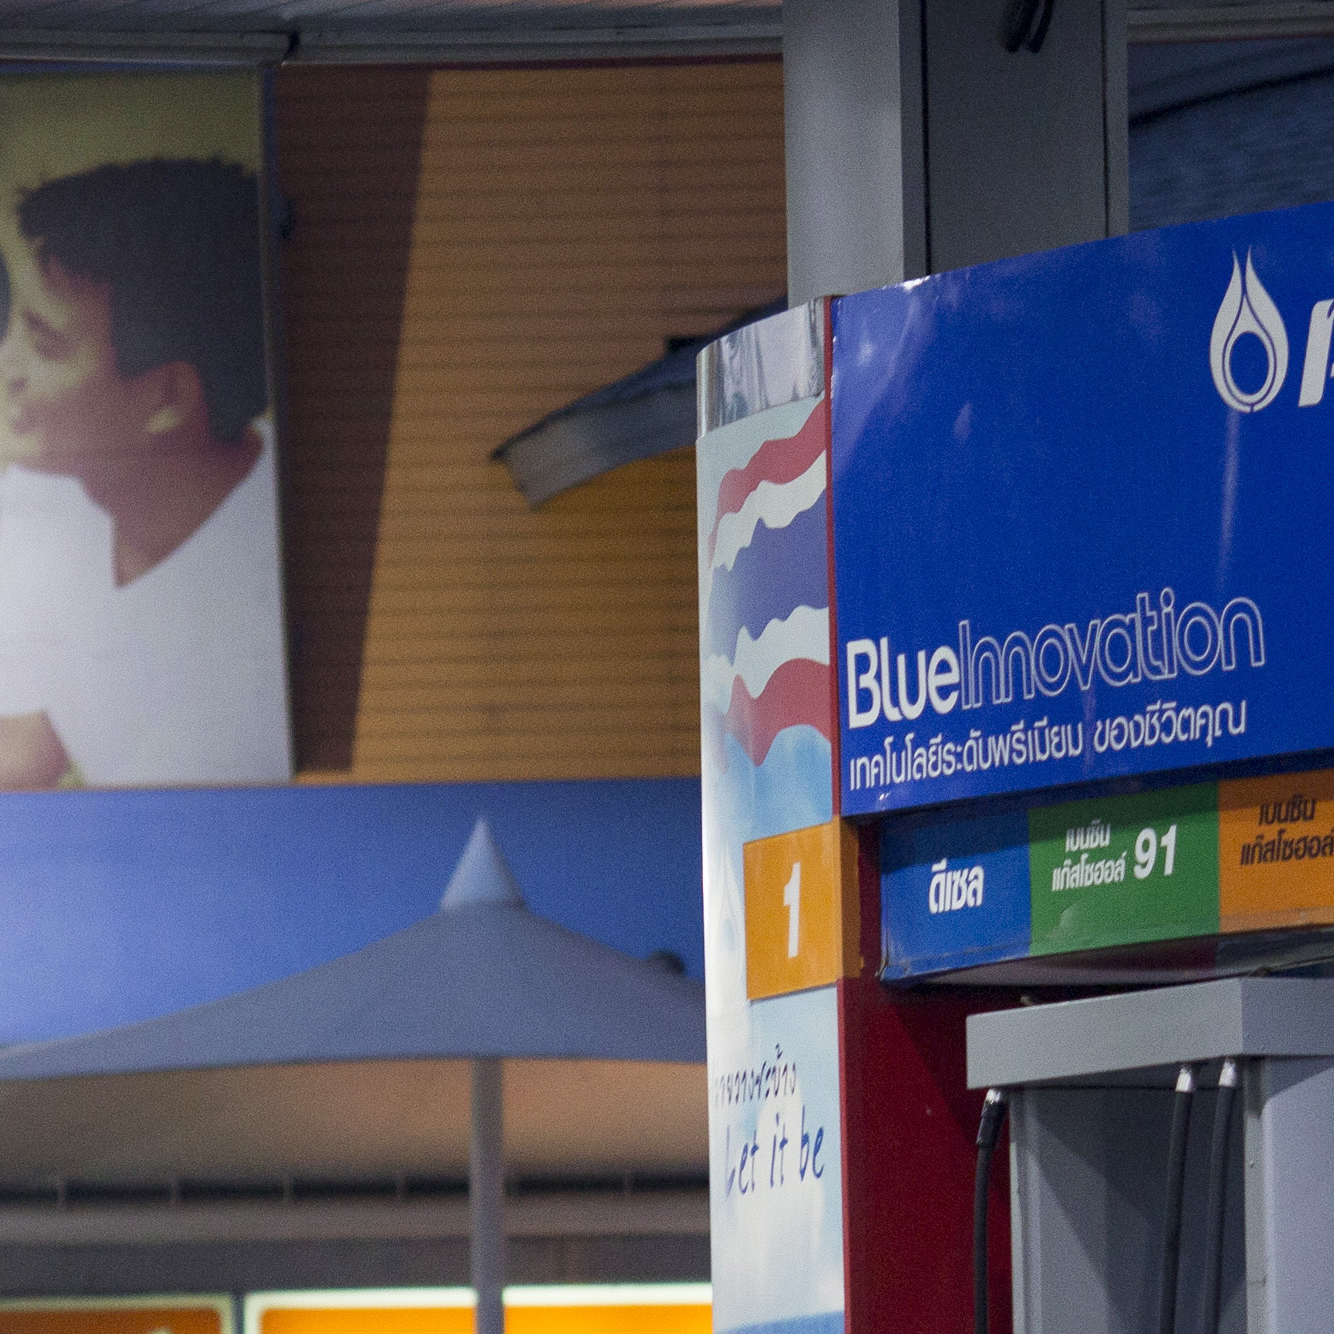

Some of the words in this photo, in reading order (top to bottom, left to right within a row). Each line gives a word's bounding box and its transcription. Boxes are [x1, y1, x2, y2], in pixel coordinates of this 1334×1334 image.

[846, 587, 1266, 728] BlueInnovation
[849, 716, 1083, 791] เทคโนโลยีระดับพรีเมียม
[1094, 699, 1247, 753] ของชีวิตคุณ
[1065, 818, 1111, 853] เบนซิน
[1133, 824, 1177, 879] 91
[783, 862, 801, 959] 1
[928, 858, 984, 914] ดีเซล
[724, 1123, 759, 1198] Let
[770, 1112, 788, 1188] it
[800, 1103, 825, 1182] be
